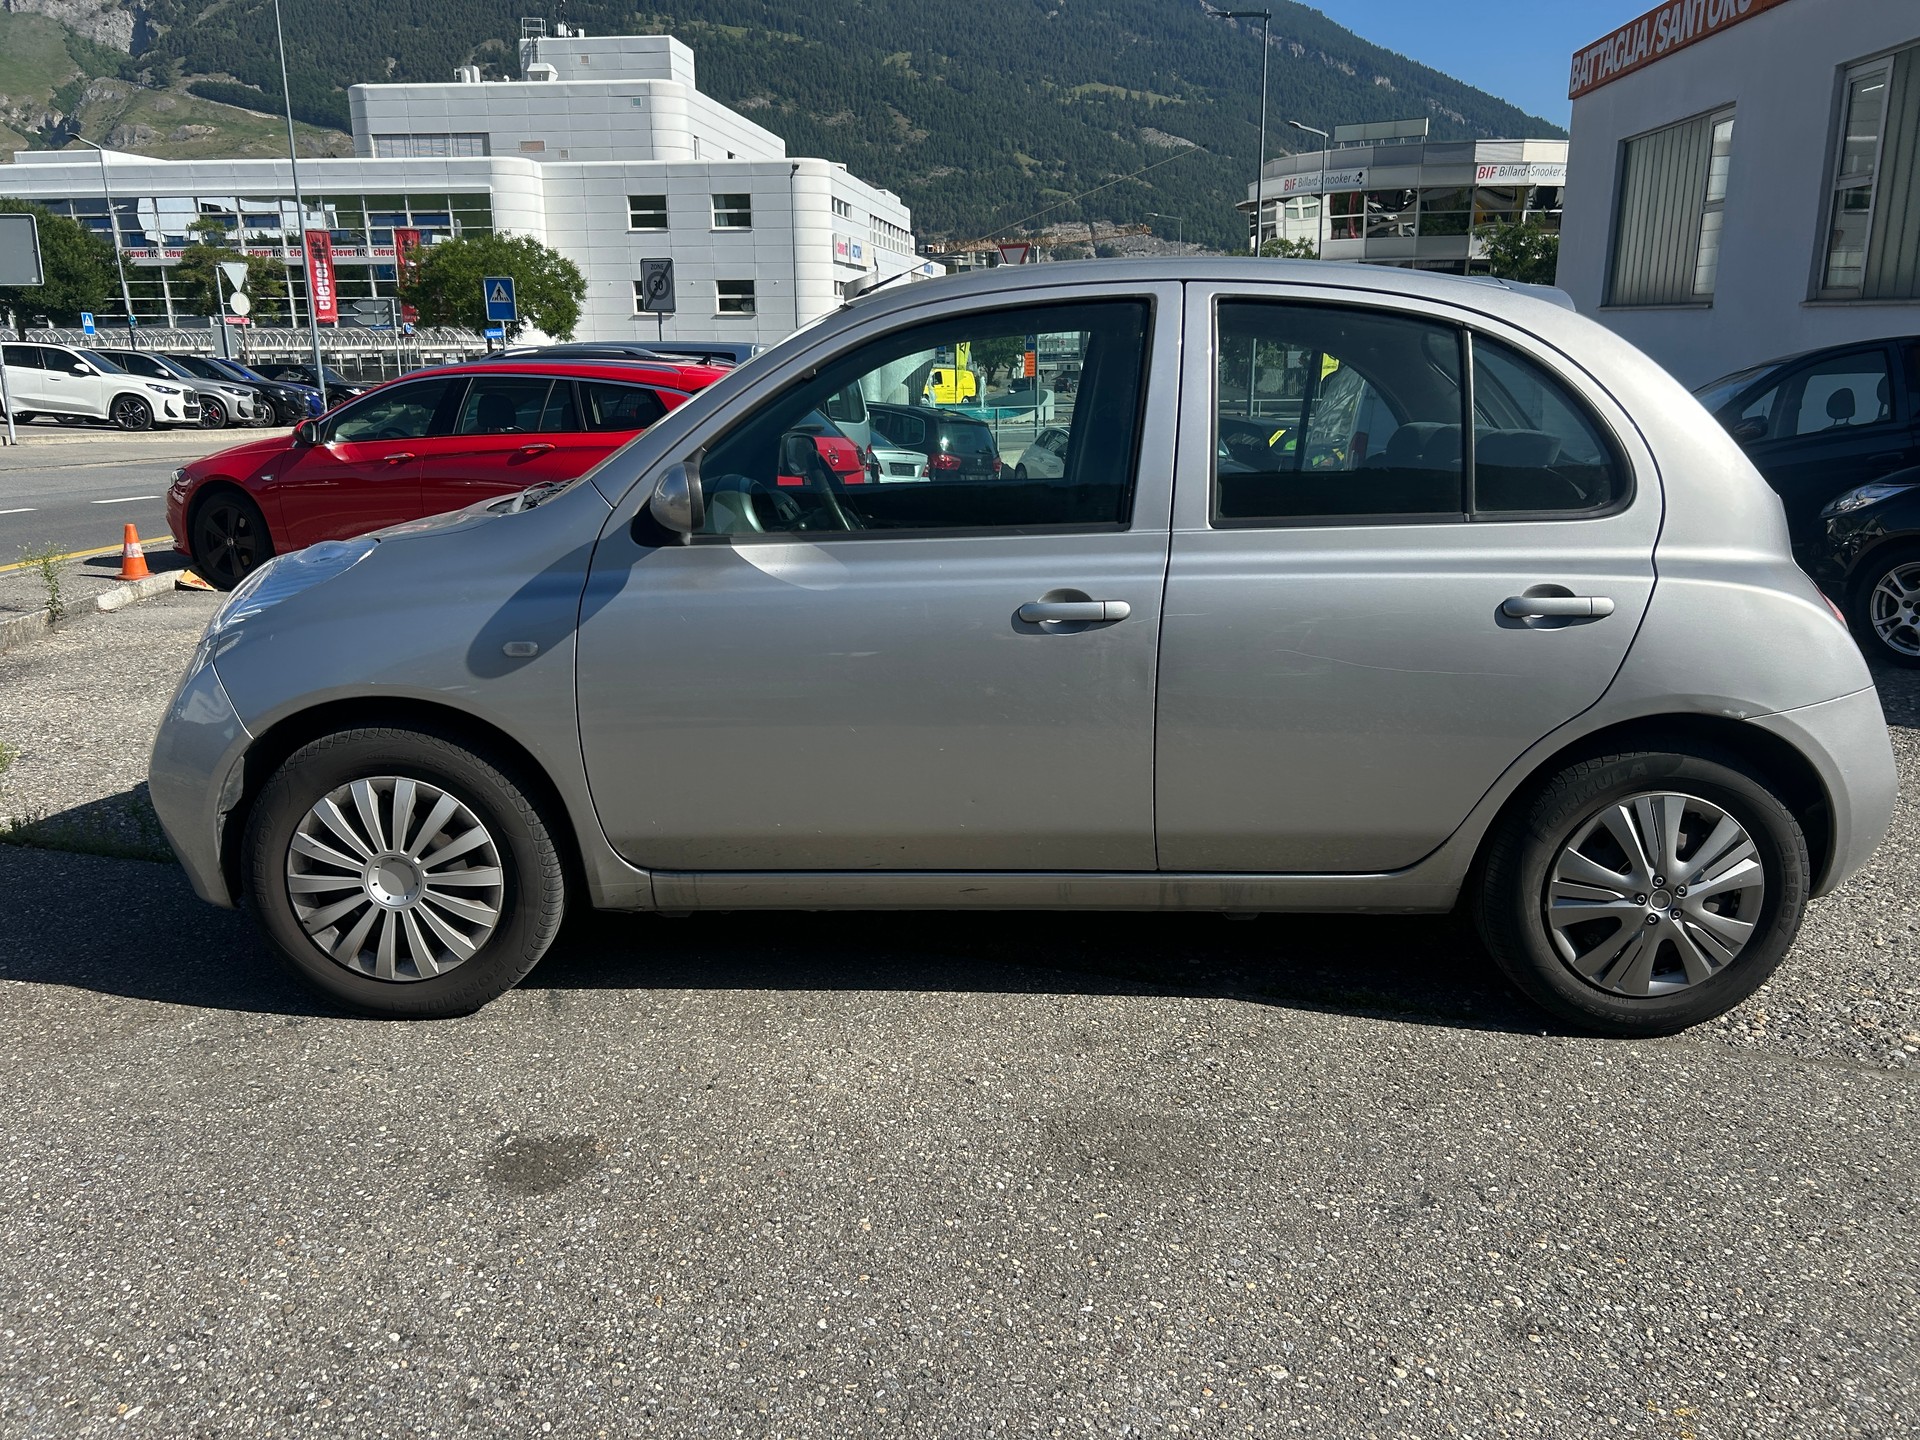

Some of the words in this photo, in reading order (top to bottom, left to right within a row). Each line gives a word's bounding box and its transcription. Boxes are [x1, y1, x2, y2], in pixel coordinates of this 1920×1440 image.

[1569, 0, 1750, 93] BATTAGLIA/SANTO
[1478, 166, 1497, 179] BIF
[1499, 165, 1527, 177] Billard
[1284, 178, 1297, 191] BIF
[1321, 173, 1351, 185] nooker
[165, 250, 186, 258] cleve
[373, 248, 395, 257] cleve
[650, 263, 665, 271] ZONE
[653, 280, 664, 291] 30
[1776, 839, 1799, 936] ENERGY
